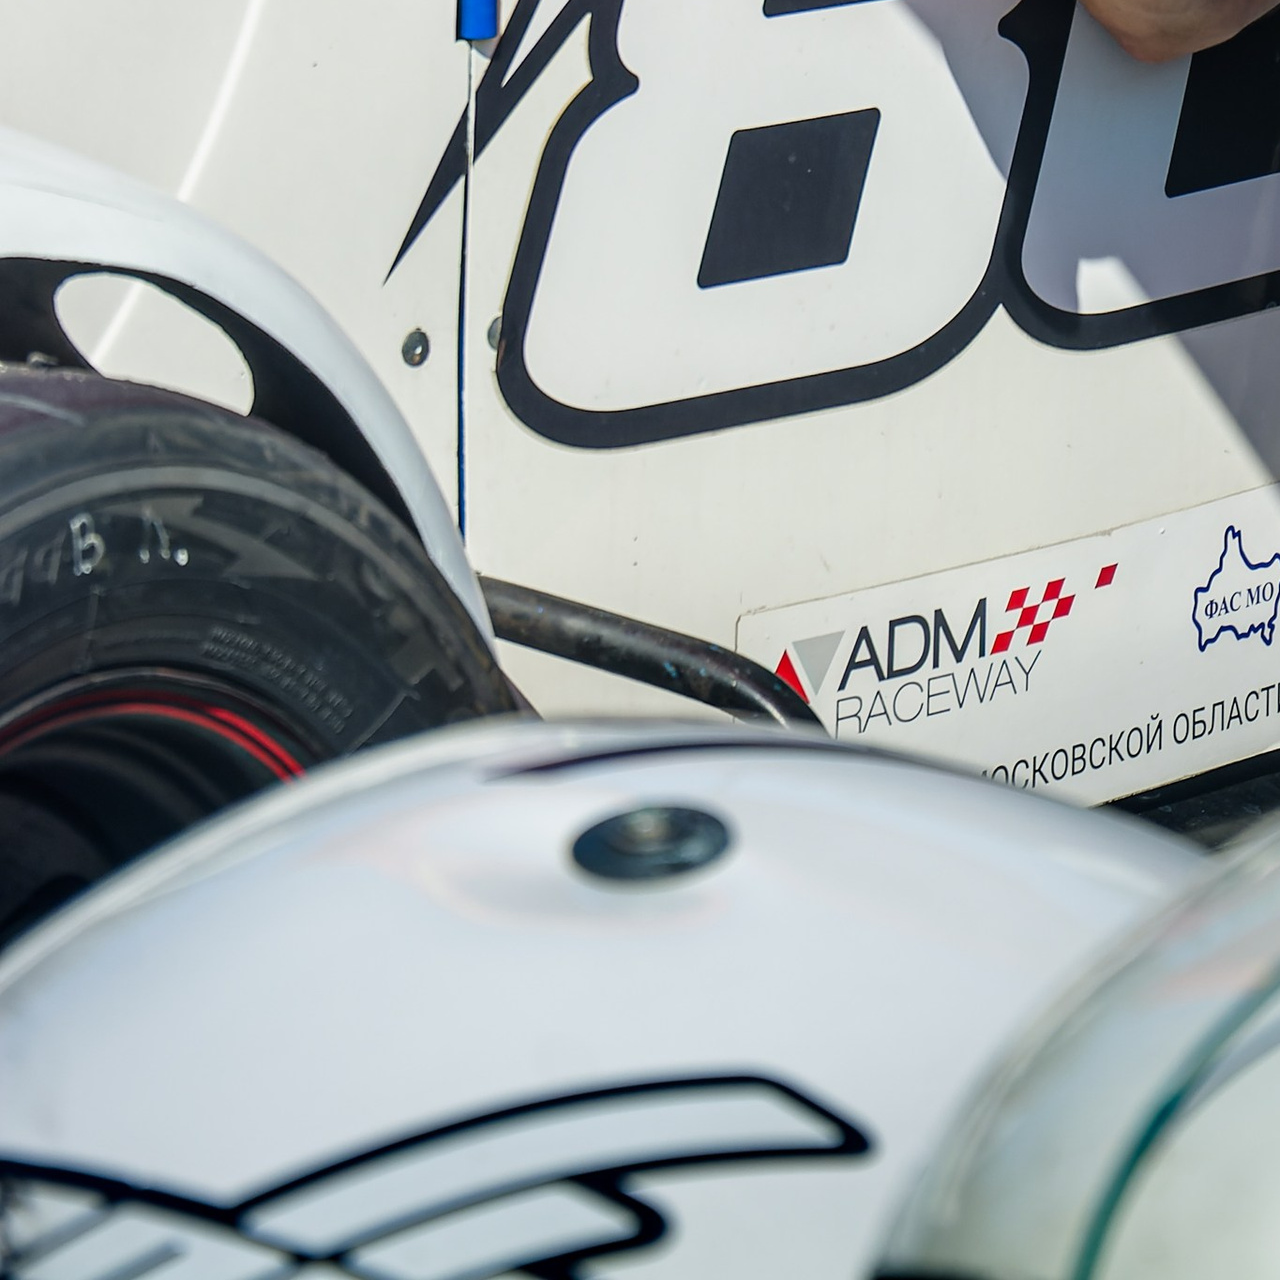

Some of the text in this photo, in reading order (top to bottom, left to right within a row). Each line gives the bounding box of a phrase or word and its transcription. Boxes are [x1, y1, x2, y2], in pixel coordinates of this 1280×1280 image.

[1204, 581, 1274, 620] ФАС МО
[837, 597, 987, 692] ADM
[835, 650, 1042, 739] RACEWAY
[980, 712, 1163, 790] ОСКОВСКОЙ
